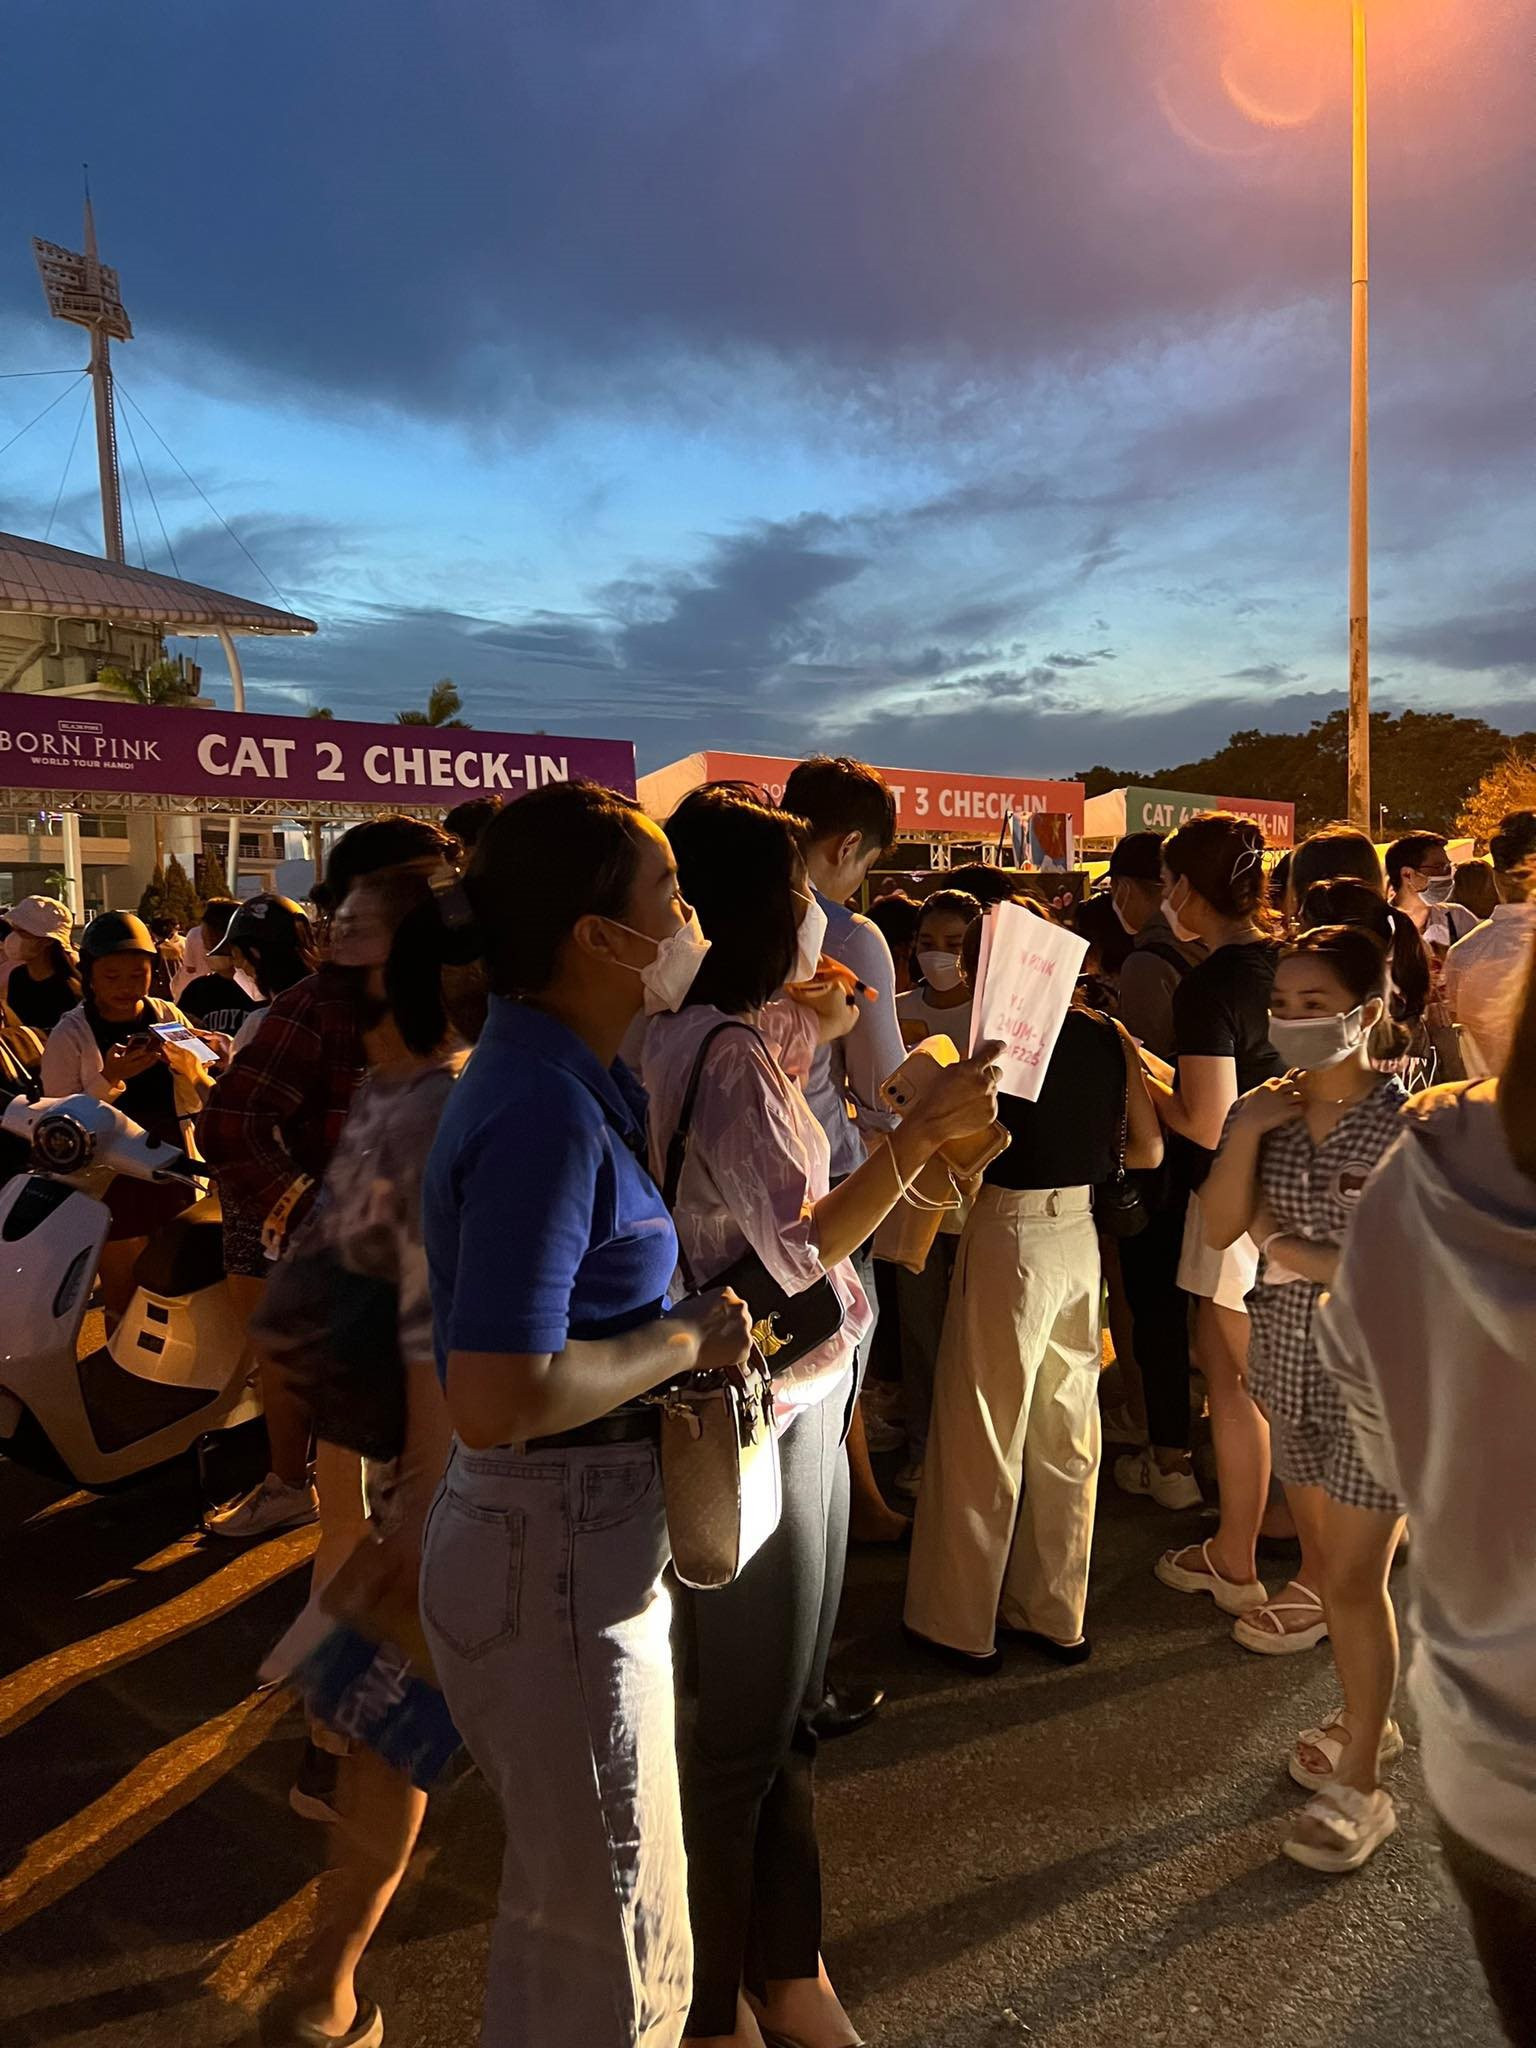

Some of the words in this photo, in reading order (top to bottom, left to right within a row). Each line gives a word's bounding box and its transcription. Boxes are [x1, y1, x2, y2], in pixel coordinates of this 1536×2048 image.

[0, 730, 81, 756] BORN
[95, 736, 161, 761] PINK
[31, 757, 70, 767] WORLD
[73, 759, 101, 768] TOUR
[197, 733, 296, 778] CAT
[315, 741, 345, 781] 2
[363, 745, 569, 790] CHECK-IN
[915, 787, 930, 816] 3
[938, 789, 1048, 820] CHECK-IN
[1142, 802, 1175, 827] CAT
